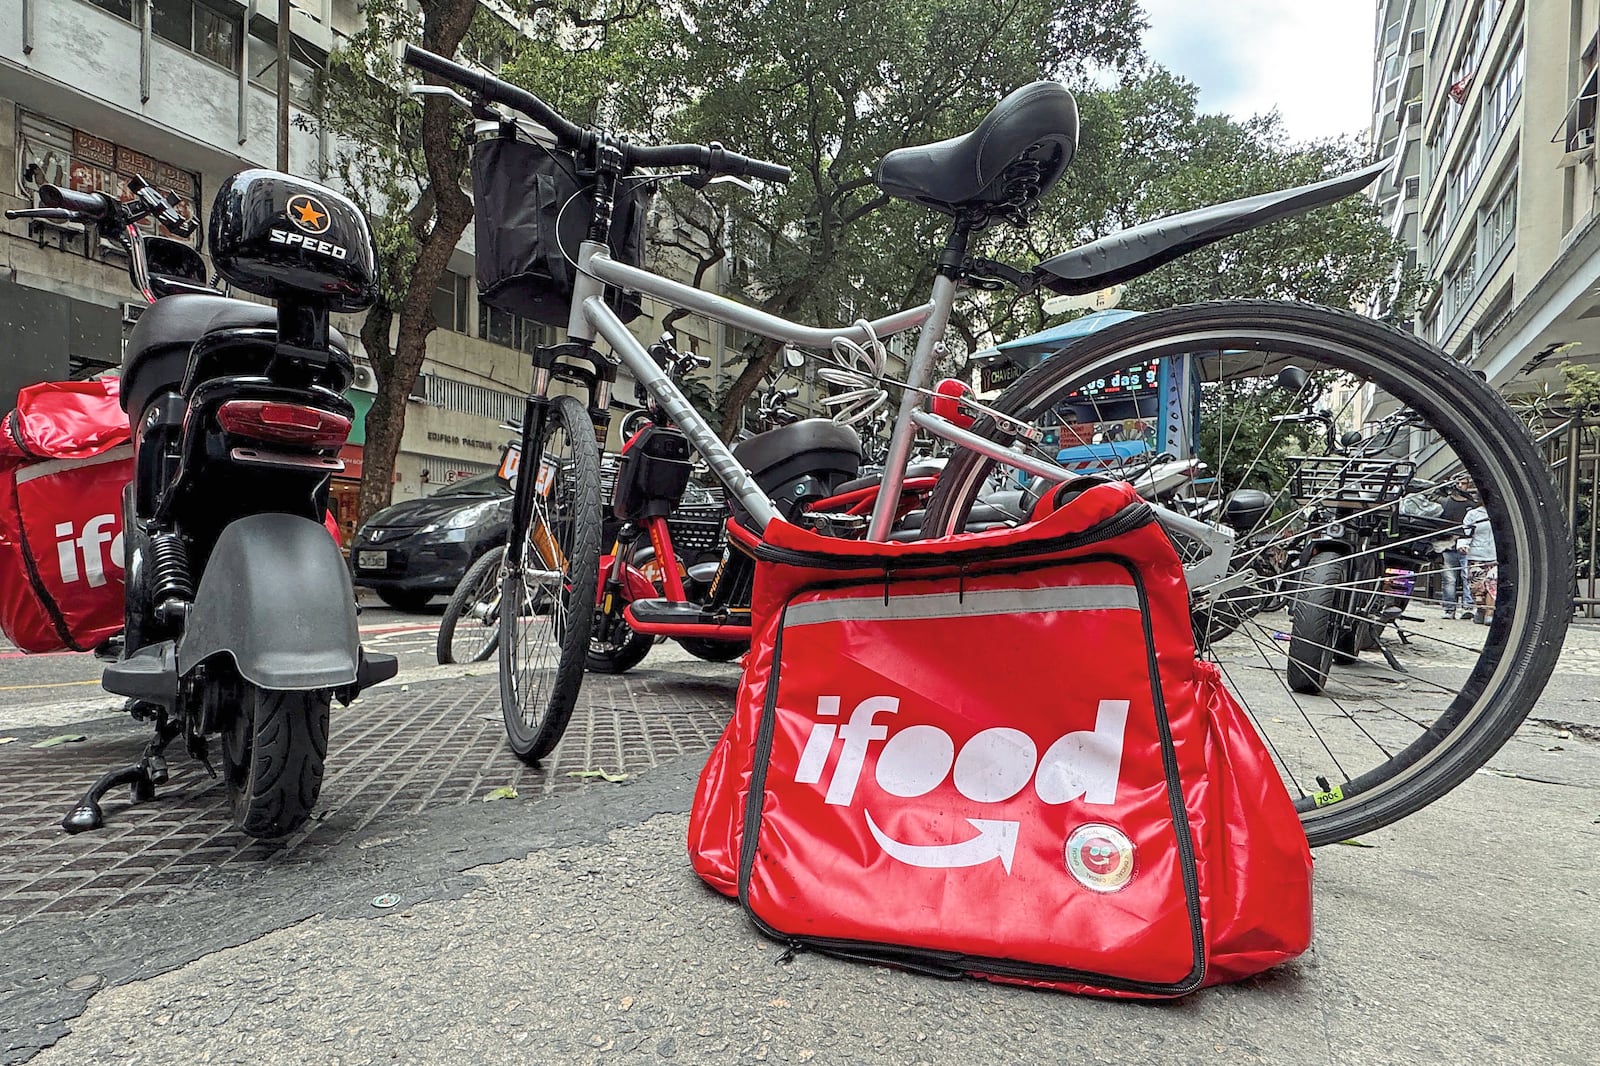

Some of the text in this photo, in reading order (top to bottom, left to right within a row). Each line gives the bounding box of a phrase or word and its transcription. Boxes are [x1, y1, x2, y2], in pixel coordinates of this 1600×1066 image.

[269, 228, 347, 260] SPEED
[55, 514, 124, 589] if
[794, 695, 1130, 807] ifood
